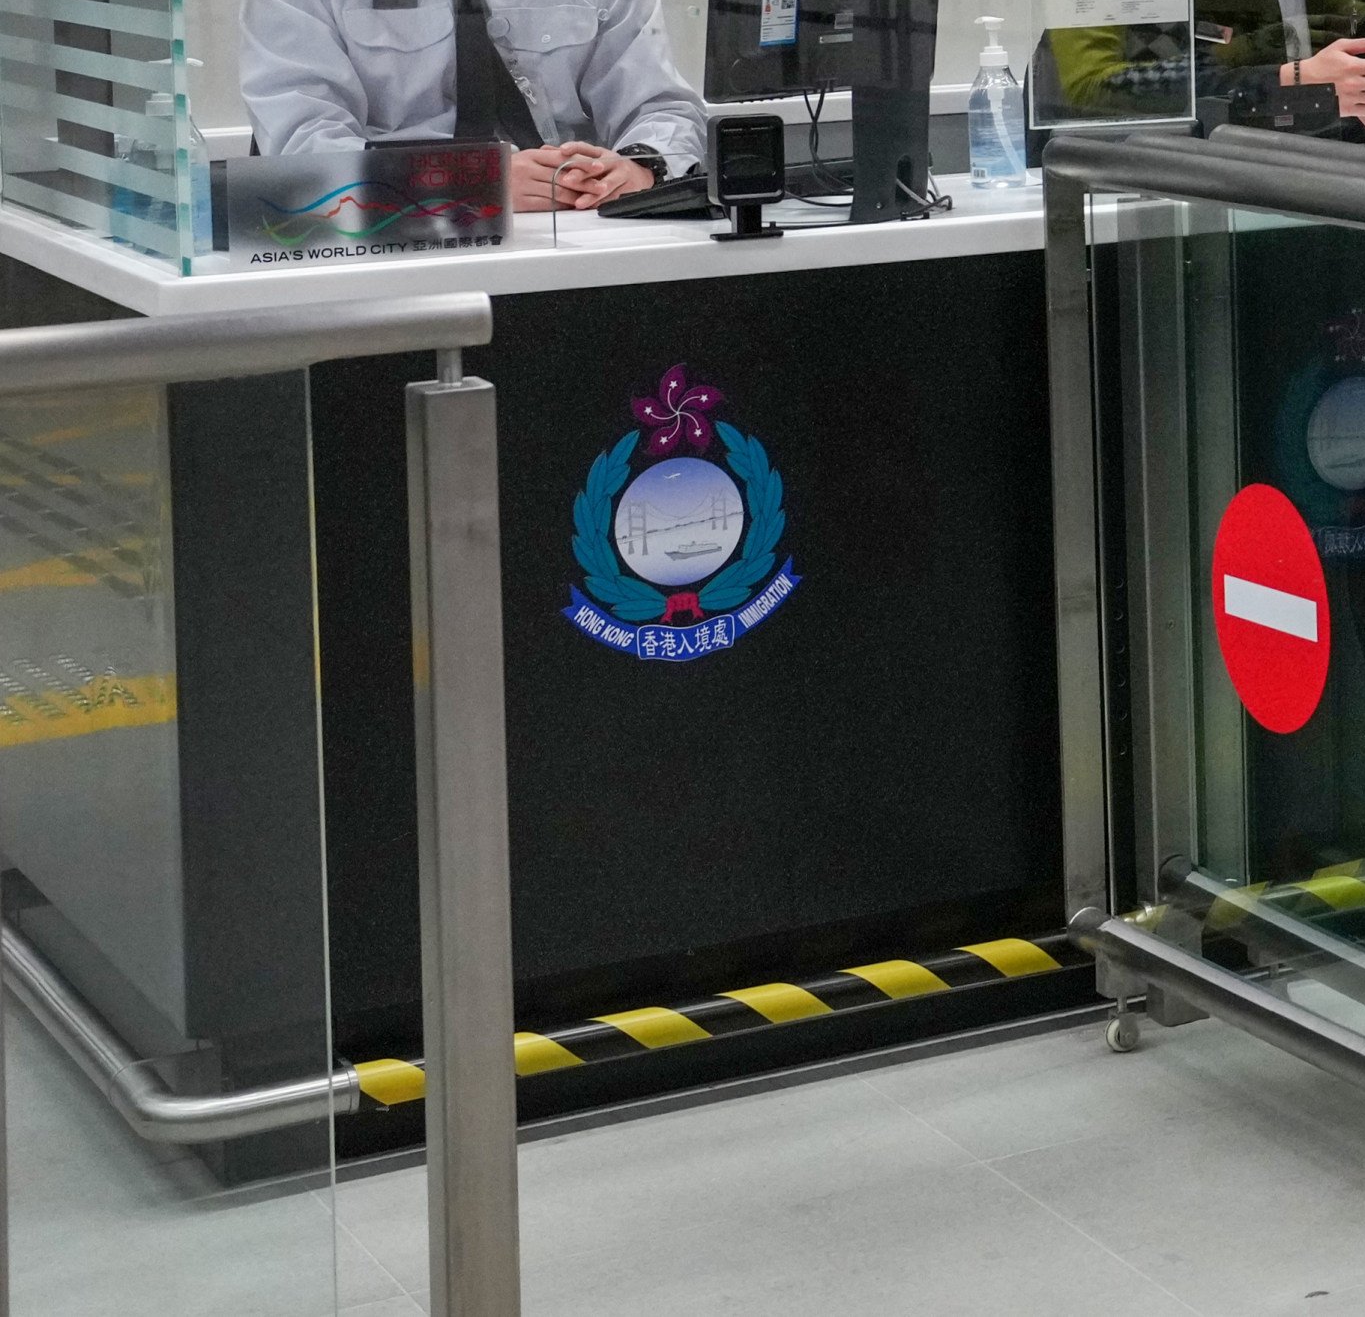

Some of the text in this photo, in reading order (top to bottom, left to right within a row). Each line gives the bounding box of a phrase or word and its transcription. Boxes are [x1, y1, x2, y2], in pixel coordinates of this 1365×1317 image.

[250, 242, 408, 265] ASIA'S WORLD CITY
[412, 234, 504, 252] 亞洲國際都會
[737, 573, 794, 630] IMMIGRATION
[573, 604, 635, 649] HONG KONG
[641, 618, 730, 658] 香港入境處
